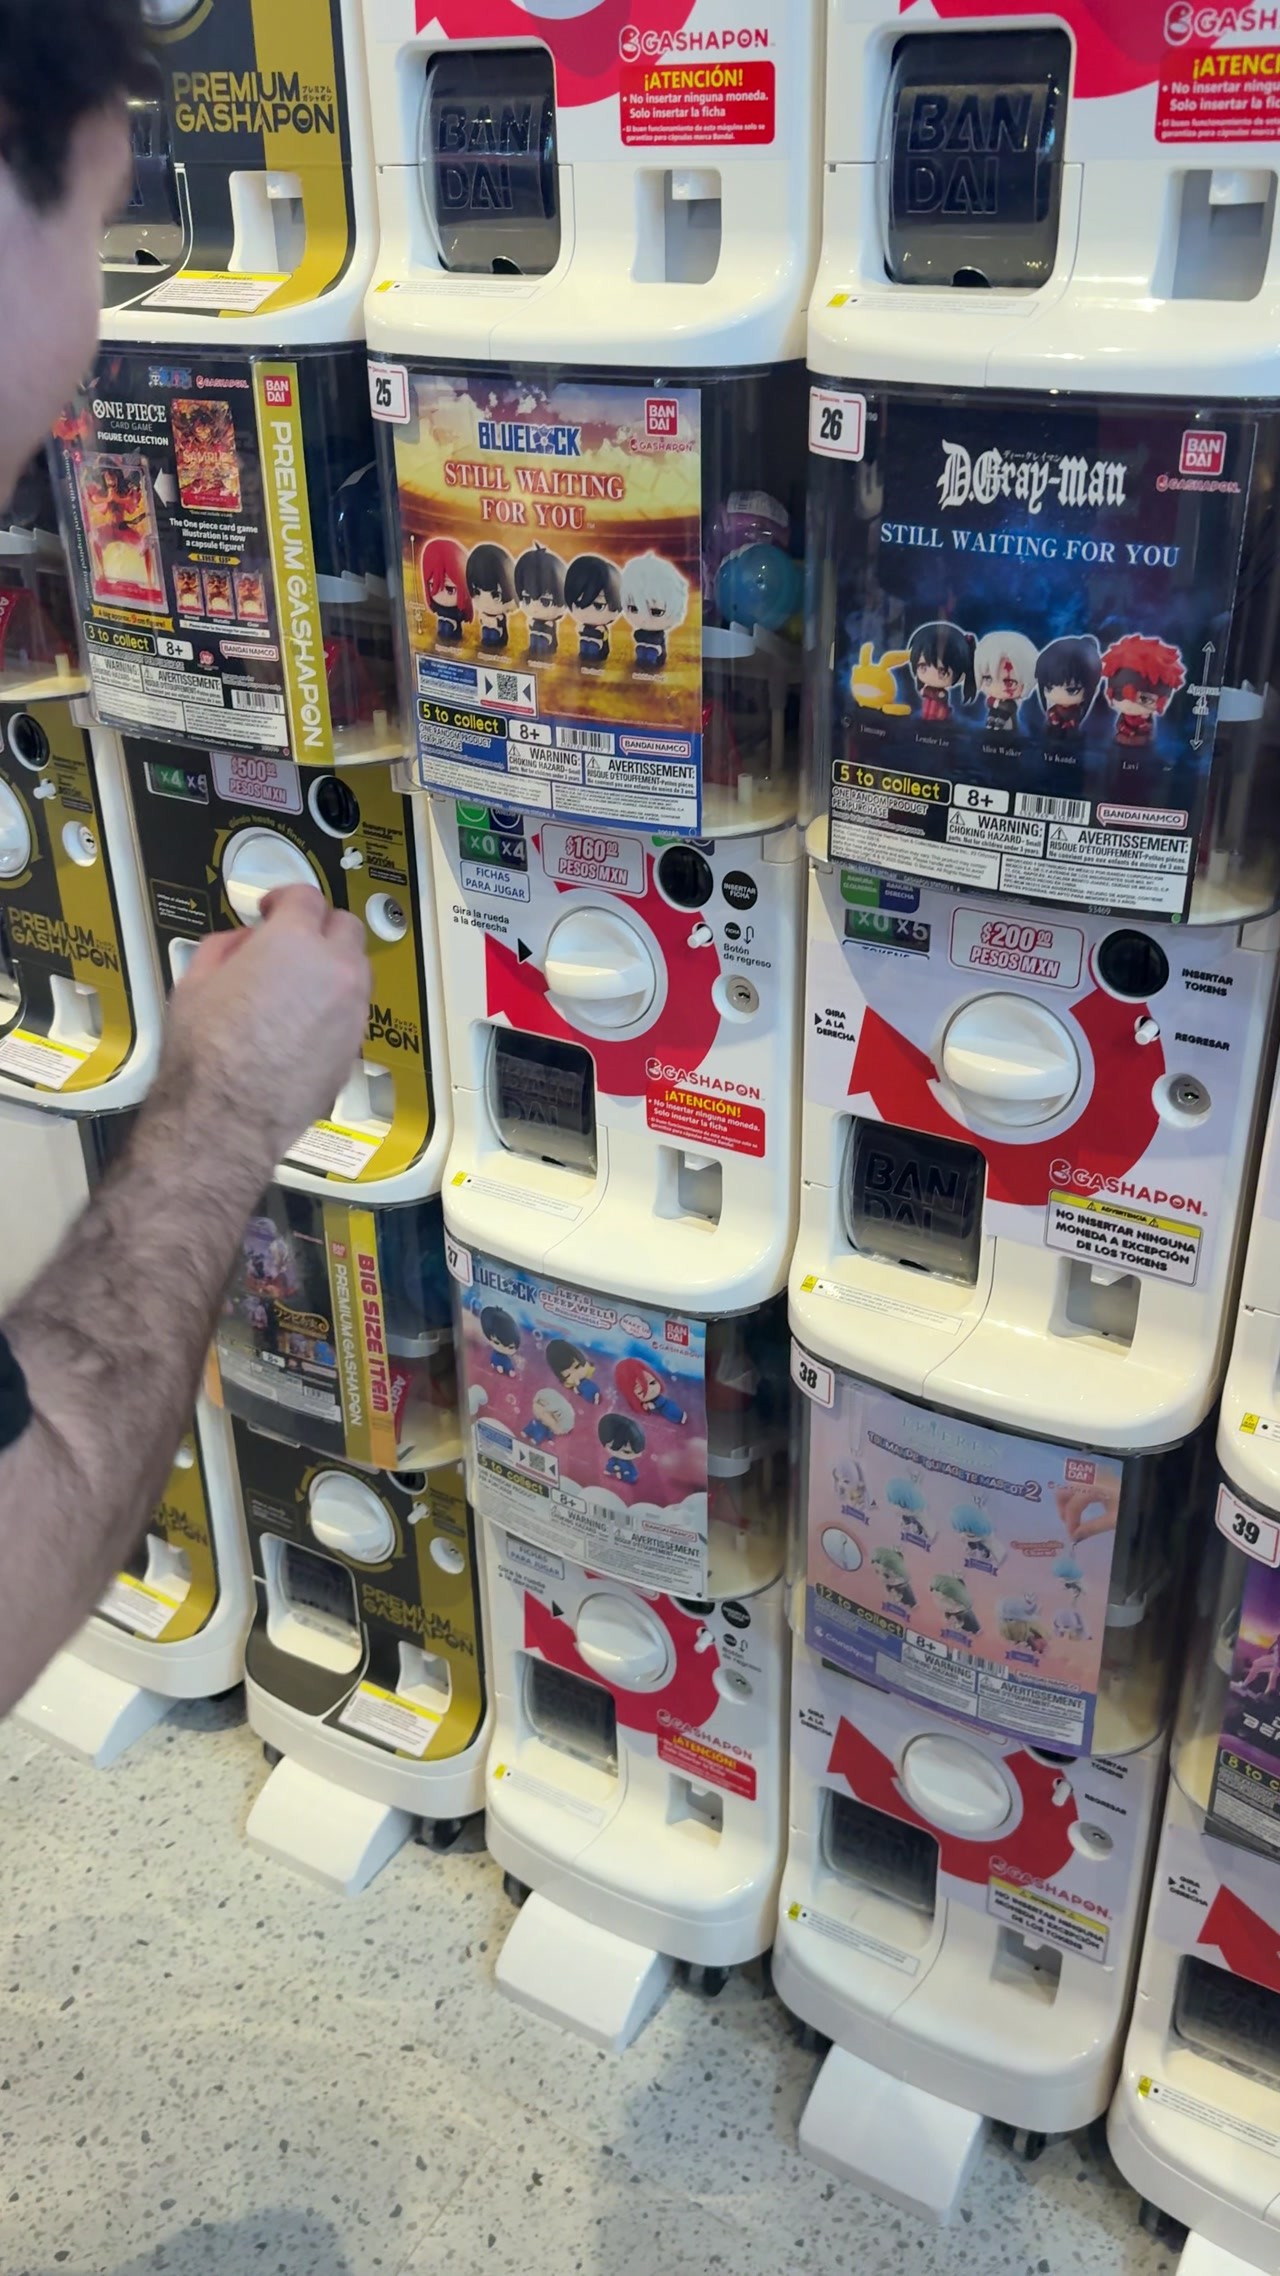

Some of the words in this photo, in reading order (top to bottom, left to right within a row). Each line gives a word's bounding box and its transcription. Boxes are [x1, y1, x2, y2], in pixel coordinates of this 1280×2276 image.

[1194, 8, 1280, 36] GASH
[642, 29, 769, 55] GASHAPON
[644, 65, 744, 91] ¡ATENCIÓN!
[1193, 53, 1280, 80] ¡ATENCI
[172, 72, 299, 102] PREMIUM
[630, 93, 644, 104] No
[646, 93, 681, 103] insertar
[684, 92, 722, 105] ninguna
[726, 90, 769, 103] moneda.
[1171, 82, 1190, 94] No
[1193, 82, 1241, 93] insertar
[630, 107, 650, 119] Solo
[653, 107, 688, 118] insertar
[691, 106, 700, 117] la
[702, 106, 726, 117] ficha
[1170, 98, 1197, 111] Solo
[1200, 98, 1248, 110] insertar
[175, 103, 335, 134] GASHAPON
[265, 379, 289, 393] BAN
[266, 391, 286, 403] DAI
[376, 377, 391, 407] 25
[126, 402, 167, 422] PIECE
[649, 405, 675, 417] BAN
[649, 420, 669, 431] DAI
[820, 407, 842, 441] 26
[97, 431, 122, 442] FIGURE
[124, 433, 169, 446] COLLECTION
[478, 422, 581, 457] BLUELOCK
[1187, 438, 1220, 453] BAN
[1186, 454, 1212, 467] DAI
[445, 462, 509, 491] STILL
[516, 468, 624, 500] WAITING
[269, 421, 305, 570] PREMIUM
[481, 499, 525, 525] FOR
[533, 503, 585, 530] YOU
[880, 523, 943, 548] STILL
[952, 530, 1058, 559] WAITING
[1066, 540, 1115, 563] FOR
[1125, 545, 1180, 568] YOU
[88, 625, 95, 639] 3
[98, 629, 109, 642] to
[112, 633, 149, 651] collect
[166, 641, 183, 656] 8+
[285, 573, 324, 748] GASHAPON
[423, 704, 431, 719] 5
[435, 706, 448, 722] to
[454, 713, 499, 734] collect
[519, 724, 540, 740] 8+
[529, 747, 580, 766] WARNING:
[625, 740, 655, 750] BANDAI
[655, 743, 686, 753] NAMCO
[608, 759, 695, 779] AVERTISSEMENT:
[1122, 761, 1139, 771] Lavi
[229, 778, 261, 798] PESOS
[262, 785, 287, 803] MXN
[840, 765, 850, 781] 5
[856, 768, 874, 786] to
[881, 775, 940, 800] collect
[832, 787, 849, 798] ONE
[850, 789, 887, 807] RANDOM
[887, 797, 928, 816] PRODUCT
[847, 799, 889, 818] PURCHASE
[967, 789, 994, 808] 8+
[978, 815, 1043, 838] WARNING:
[1103, 809, 1140, 821] BANDAI
[1141, 813, 1181, 824] NAMCO
[949, 825, 985, 839] CHOKING
[1078, 831, 1189, 854] AVERTISSEMENT:
[1050, 841, 1077, 852] RISQUE
[476, 867, 510, 882] FICHAS
[559, 857, 597, 880] PESOS
[598, 865, 629, 886] MXN
[465, 878, 491, 892] PARA
[493, 884, 525, 899] JUGAR
[452, 905, 472, 917] Gira
[473, 909, 482, 919] la
[483, 913, 510, 925] rueda
[460, 916, 469, 925] la
[470, 919, 507, 933] derecha
[7, 906, 95, 948] PREMIUM
[11, 925, 119, 973] GASHAPON
[724, 943, 750, 955] Botón
[724, 953, 735, 961] de
[736, 956, 772, 968] regreso
[970, 945, 1019, 972] PESOS
[1019, 955, 1060, 979] MXN
[1182, 968, 1233, 986] INSERTAR
[1185, 981, 1227, 996] TOKENS
[817, 1027, 855, 1042] DERECHA
[834, 1020, 845, 1029] LA
[1175, 1032, 1230, 1051] REGRESAR
[663, 1065, 761, 1100] GASHAPON
[665, 1090, 742, 1118] ¡ATENCIÓN!
[653, 1107, 670, 1118] Solo
[671, 1111, 700, 1125] insertar
[709, 1121, 728, 1132] ficha
[666, 1100, 694, 1115] insertar
[695, 1110, 726, 1124] ninguna
[727, 1118, 761, 1132] moneda.
[1072, 1169, 1202, 1216] GASHAPON
[1056, 1209, 1074, 1221] NO
[1077, 1215, 1133, 1237] INSERTAR
[1137, 1231, 1196, 1254] NINGUNA
[1055, 1222, 1107, 1242] MONEDA
[1110, 1236, 1119, 1246] A
[1122, 1239, 1190, 1265] EXCEPCIÓN
[1076, 1240, 1091, 1251] DE
[1094, 1244, 1118, 1258] LOS
[1121, 1251, 1168, 1272] TOKENS
[358, 1253, 378, 1296] BIG
[472, 1266, 537, 1304] LUELOCK
[362, 1300, 384, 1354] SIZE
[666, 1322, 687, 1335] BAN
[368, 1358, 389, 1412] ITEM
[799, 1362, 817, 1389] 38
[1067, 1471, 1088, 1481] DAI
[1068, 1462, 1093, 1473] BAN
[1232, 1513, 1260, 1544] 39
[857, 1607, 903, 1637] collect
[916, 1636, 937, 1653] 8+
[1228, 1755, 1238, 1769] 8
[1245, 1764, 1262, 1781] to
